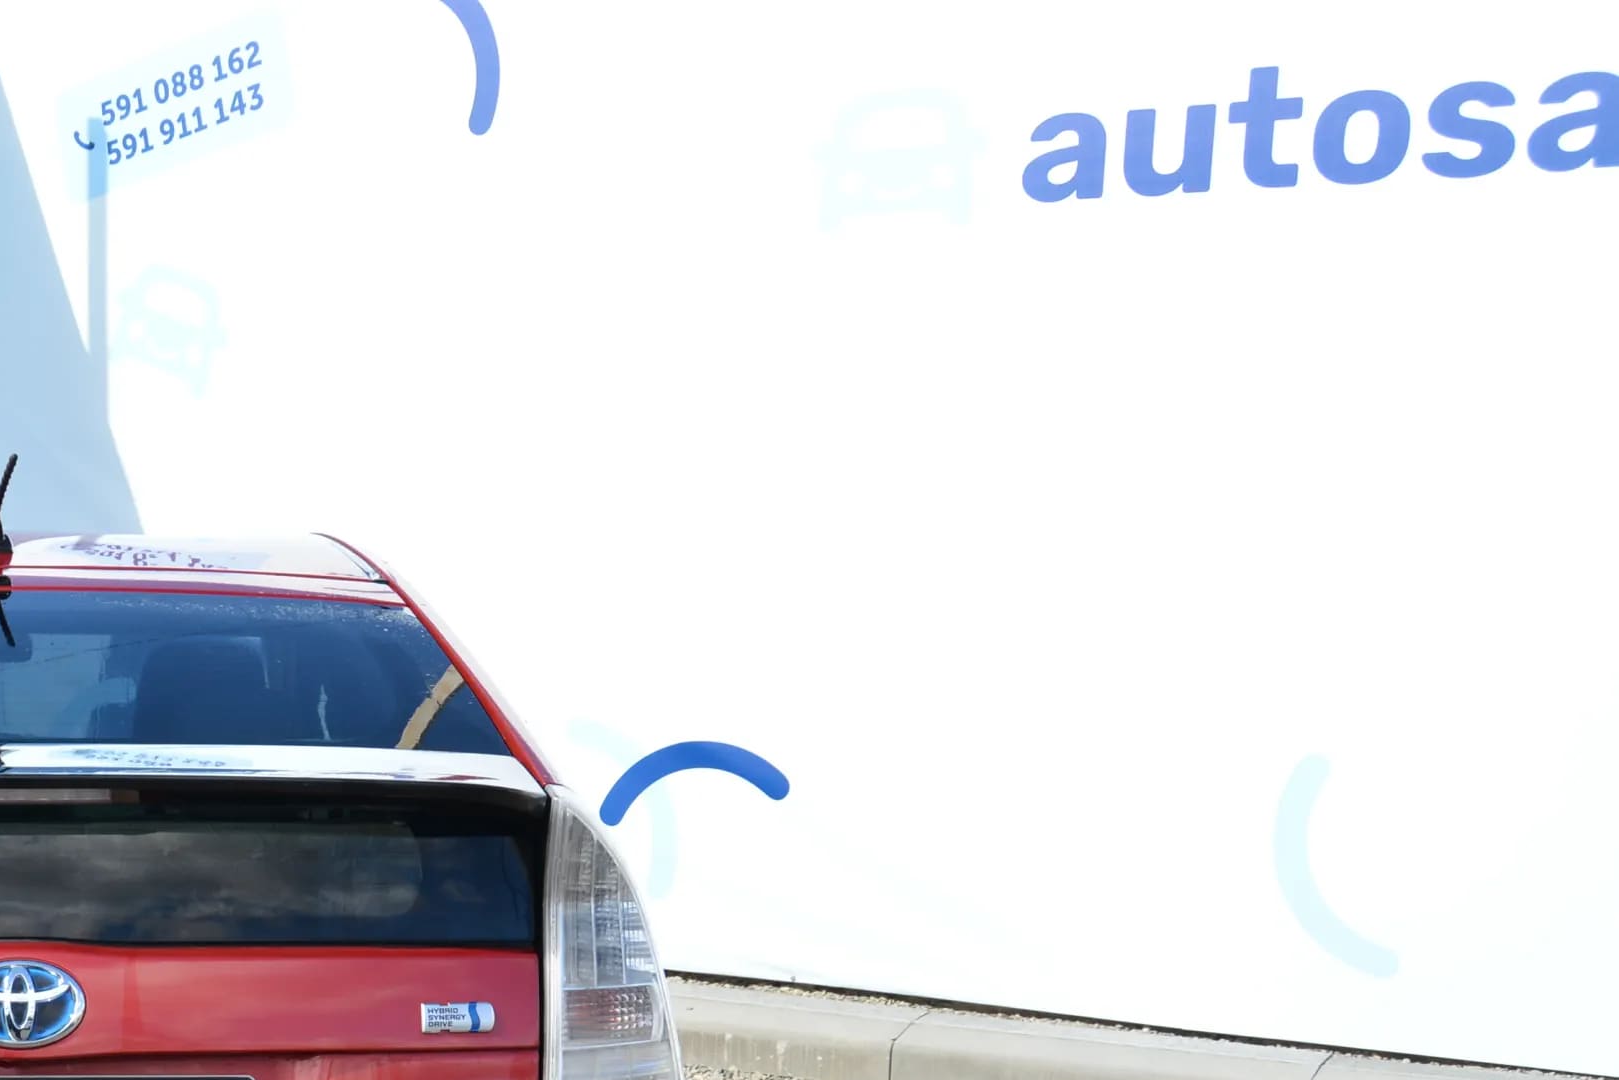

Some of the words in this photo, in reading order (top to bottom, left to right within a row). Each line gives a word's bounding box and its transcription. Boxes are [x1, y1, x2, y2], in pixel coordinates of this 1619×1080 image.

[99, 87, 148, 126] 591
[154, 63, 204, 104] 088
[212, 40, 263, 82] 162
[106, 127, 154, 165] 591
[159, 106, 208, 145] 911
[213, 82, 264, 125] 143
[1021, 65, 1619, 204] autosa
